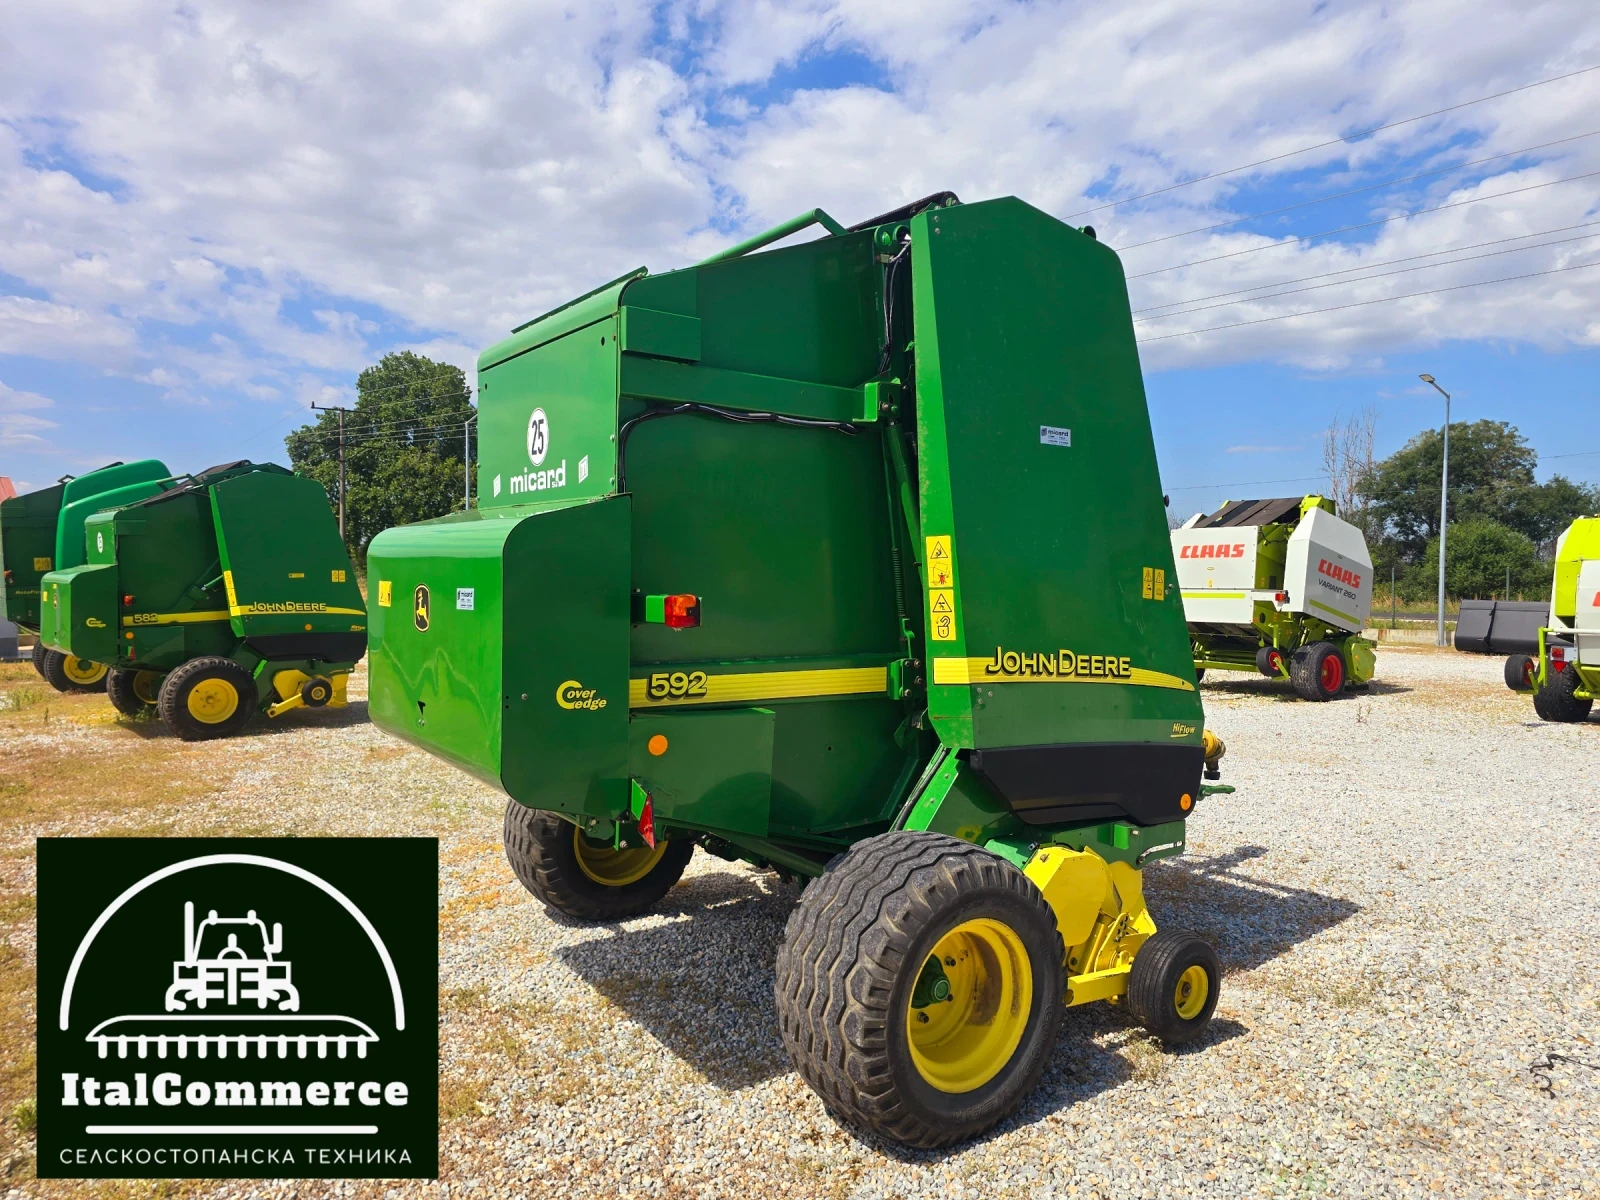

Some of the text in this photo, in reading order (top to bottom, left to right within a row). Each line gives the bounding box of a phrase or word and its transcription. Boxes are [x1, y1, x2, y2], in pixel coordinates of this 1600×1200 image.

[531, 418, 545, 456] 25
[510, 459, 567, 494] micard
[1179, 543, 1246, 559] CLAAS
[1317, 558, 1362, 589] CLAAS
[1318, 578, 1357, 600] VARIANT 260
[133, 612, 159, 624] 582
[986, 646, 1132, 679] JOHN DEERE
[555, 679, 598, 710] Cover
[647, 670, 708, 702] 592
[573, 696, 608, 711] edge
[1172, 722, 1197, 735] HiFlow
